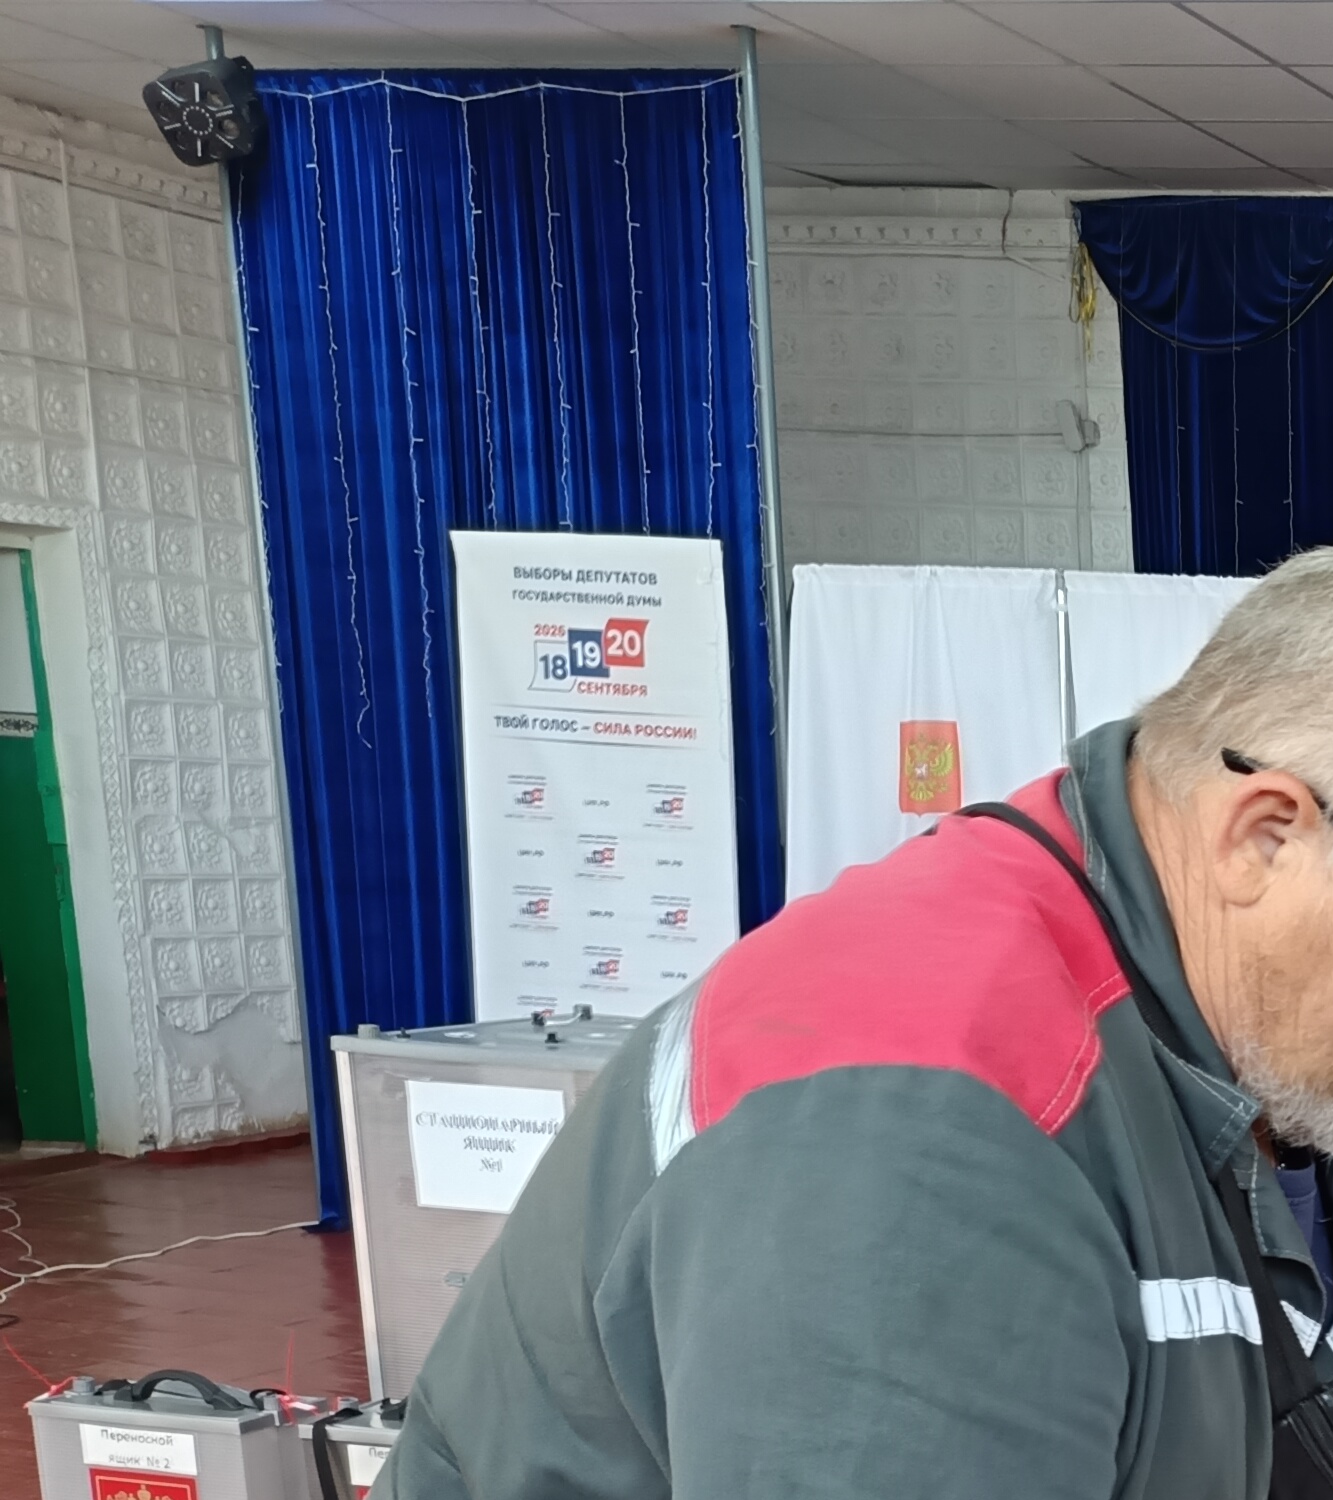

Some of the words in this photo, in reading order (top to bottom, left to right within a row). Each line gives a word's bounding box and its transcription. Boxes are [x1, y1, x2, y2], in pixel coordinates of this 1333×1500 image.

[513, 566, 572, 581] ВЫБОРЫ
[576, 569, 658, 585] ДЕПУТАТОВ
[512, 589, 624, 605] ГОСУДАРСТВЕННОЙ
[626, 595, 662, 607] ДУМЫ
[539, 654, 568, 680] 18
[572, 640, 601, 669] 19
[607, 629, 641, 657] 20
[577, 681, 648, 697] СЕНТЯБРЯ
[494, 714, 529, 730] ТВОЙ
[532, 717, 578, 732] ГОЛОС
[593, 721, 632, 735] СИЛА
[635, 723, 697, 740] РОССИИ!
[101, 1429, 173, 1446] Переносной
[109, 1454, 140, 1466] ящик
[164, 1458, 171, 1469] 2
